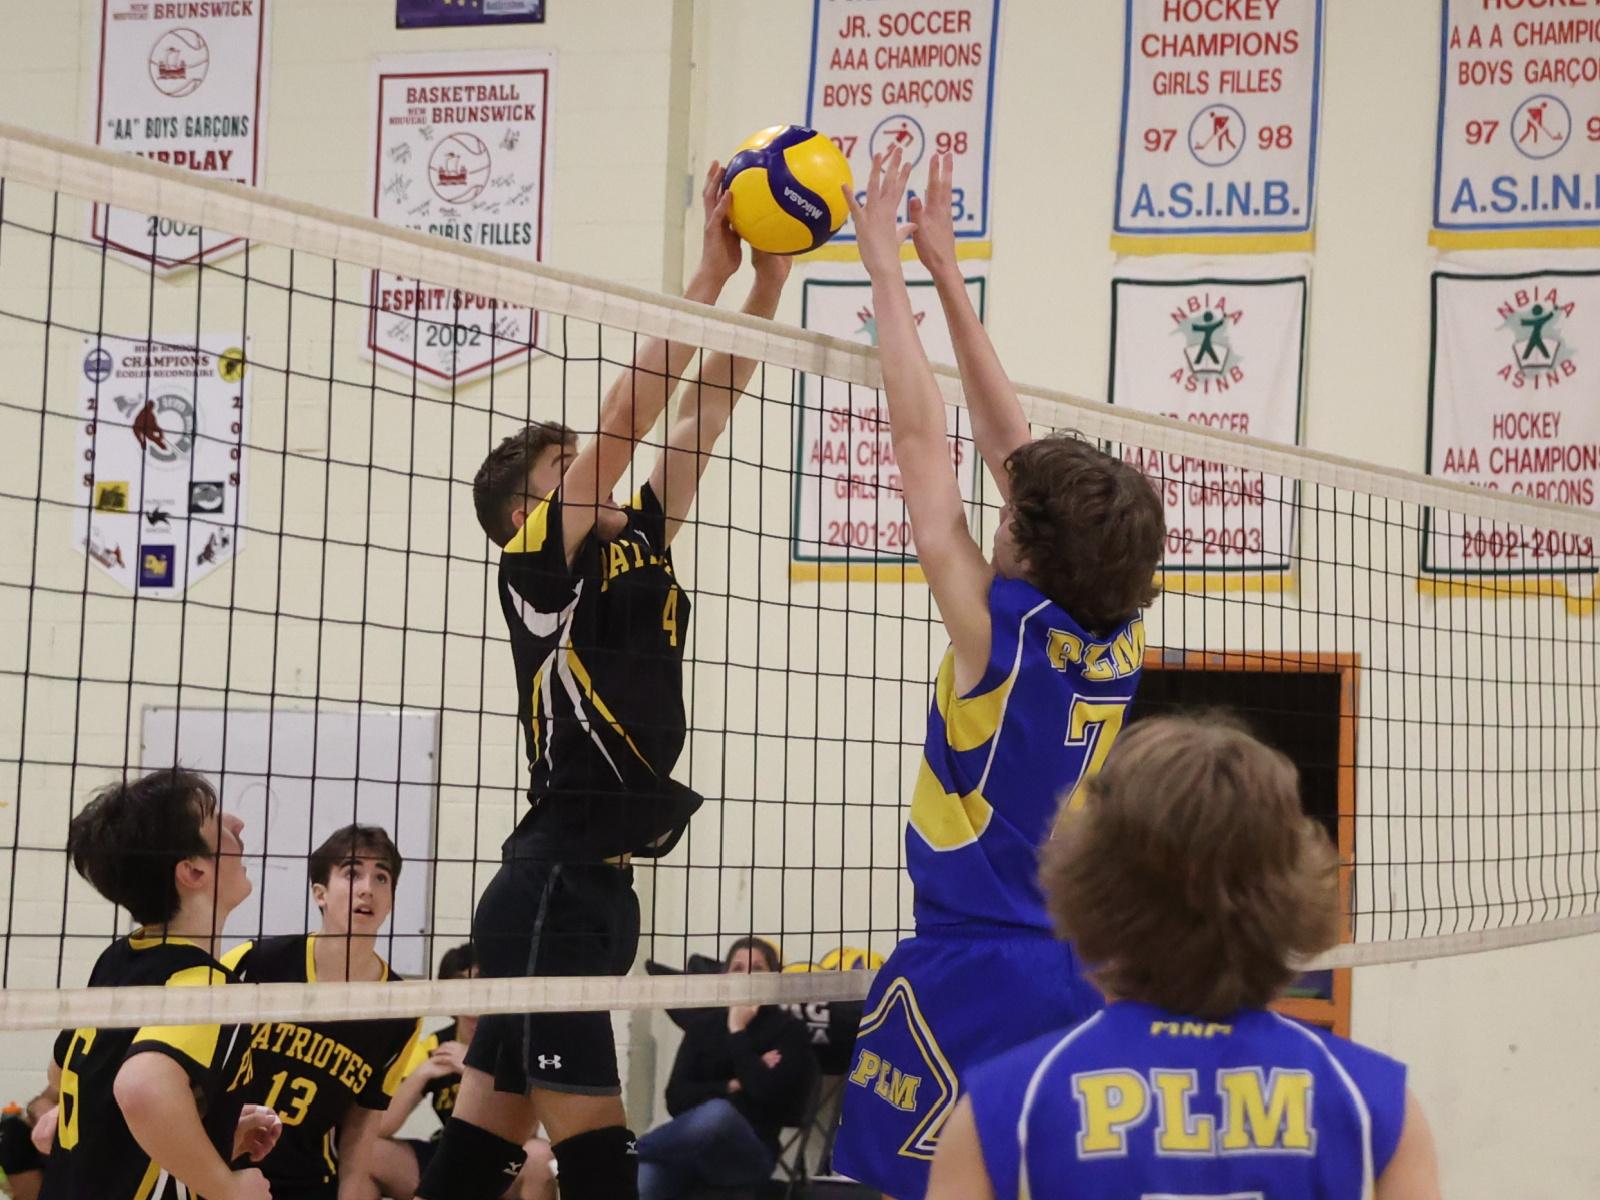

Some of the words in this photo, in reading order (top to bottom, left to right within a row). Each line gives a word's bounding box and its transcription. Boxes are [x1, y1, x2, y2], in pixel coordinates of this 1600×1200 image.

[154, 1, 254, 19] BRUNSWICK
[839, 15, 871, 38] JR.
[878, 10, 972, 37] SOCCER
[1163, 0, 1280, 21] HOCKEY
[1141, 29, 1299, 58] CHAMPIONS
[1513, 20, 1600, 47] CHAMPI
[830, 47, 868, 70] AAA
[875, 43, 982, 70] CHAMPIONS
[1152, 70, 1209, 95] GIRLS
[1219, 68, 1282, 94] FILLES
[1458, 60, 1513, 85] BOYS
[1524, 57, 1600, 86] GARÇO
[406, 84, 520, 104] BASKETBALL
[823, 83, 872, 107] BOYS
[882, 79, 973, 108] GARÇONS
[431, 104, 536, 123] BRUNSWICK
[145, 117, 178, 139] BOYS
[1143, 128, 1178, 152] 97
[1258, 125, 1293, 150] 98
[1465, 120, 1499, 145] 97
[935, 131, 968, 155] 98
[1130, 180, 1300, 218] A.S.I.N.B.
[1450, 173, 1600, 213] A.S.I.N.
[1170, 293, 1243, 325] NBIAA
[1497, 286, 1575, 319] NBIAA
[426, 323, 481, 347] 2002
[122, 355, 210, 368] CHAMPIONS
[1497, 359, 1577, 390] ASINB
[1170, 365, 1244, 394] ASINB
[1493, 412, 1561, 440] HOCKEY
[811, 440, 848, 464] AAA
[1443, 447, 1480, 473] AAA
[1489, 444, 1600, 474] CHAMPION
[828, 521, 912, 546] 2001-20
[662, 584, 679, 647] 4
[1046, 618, 1146, 682] PLM
[1063, 692, 1132, 806] 7
[848, 1048, 922, 1112] PLM
[264, 1070, 318, 1126] 13
[1070, 1065, 1317, 1161] PLM
